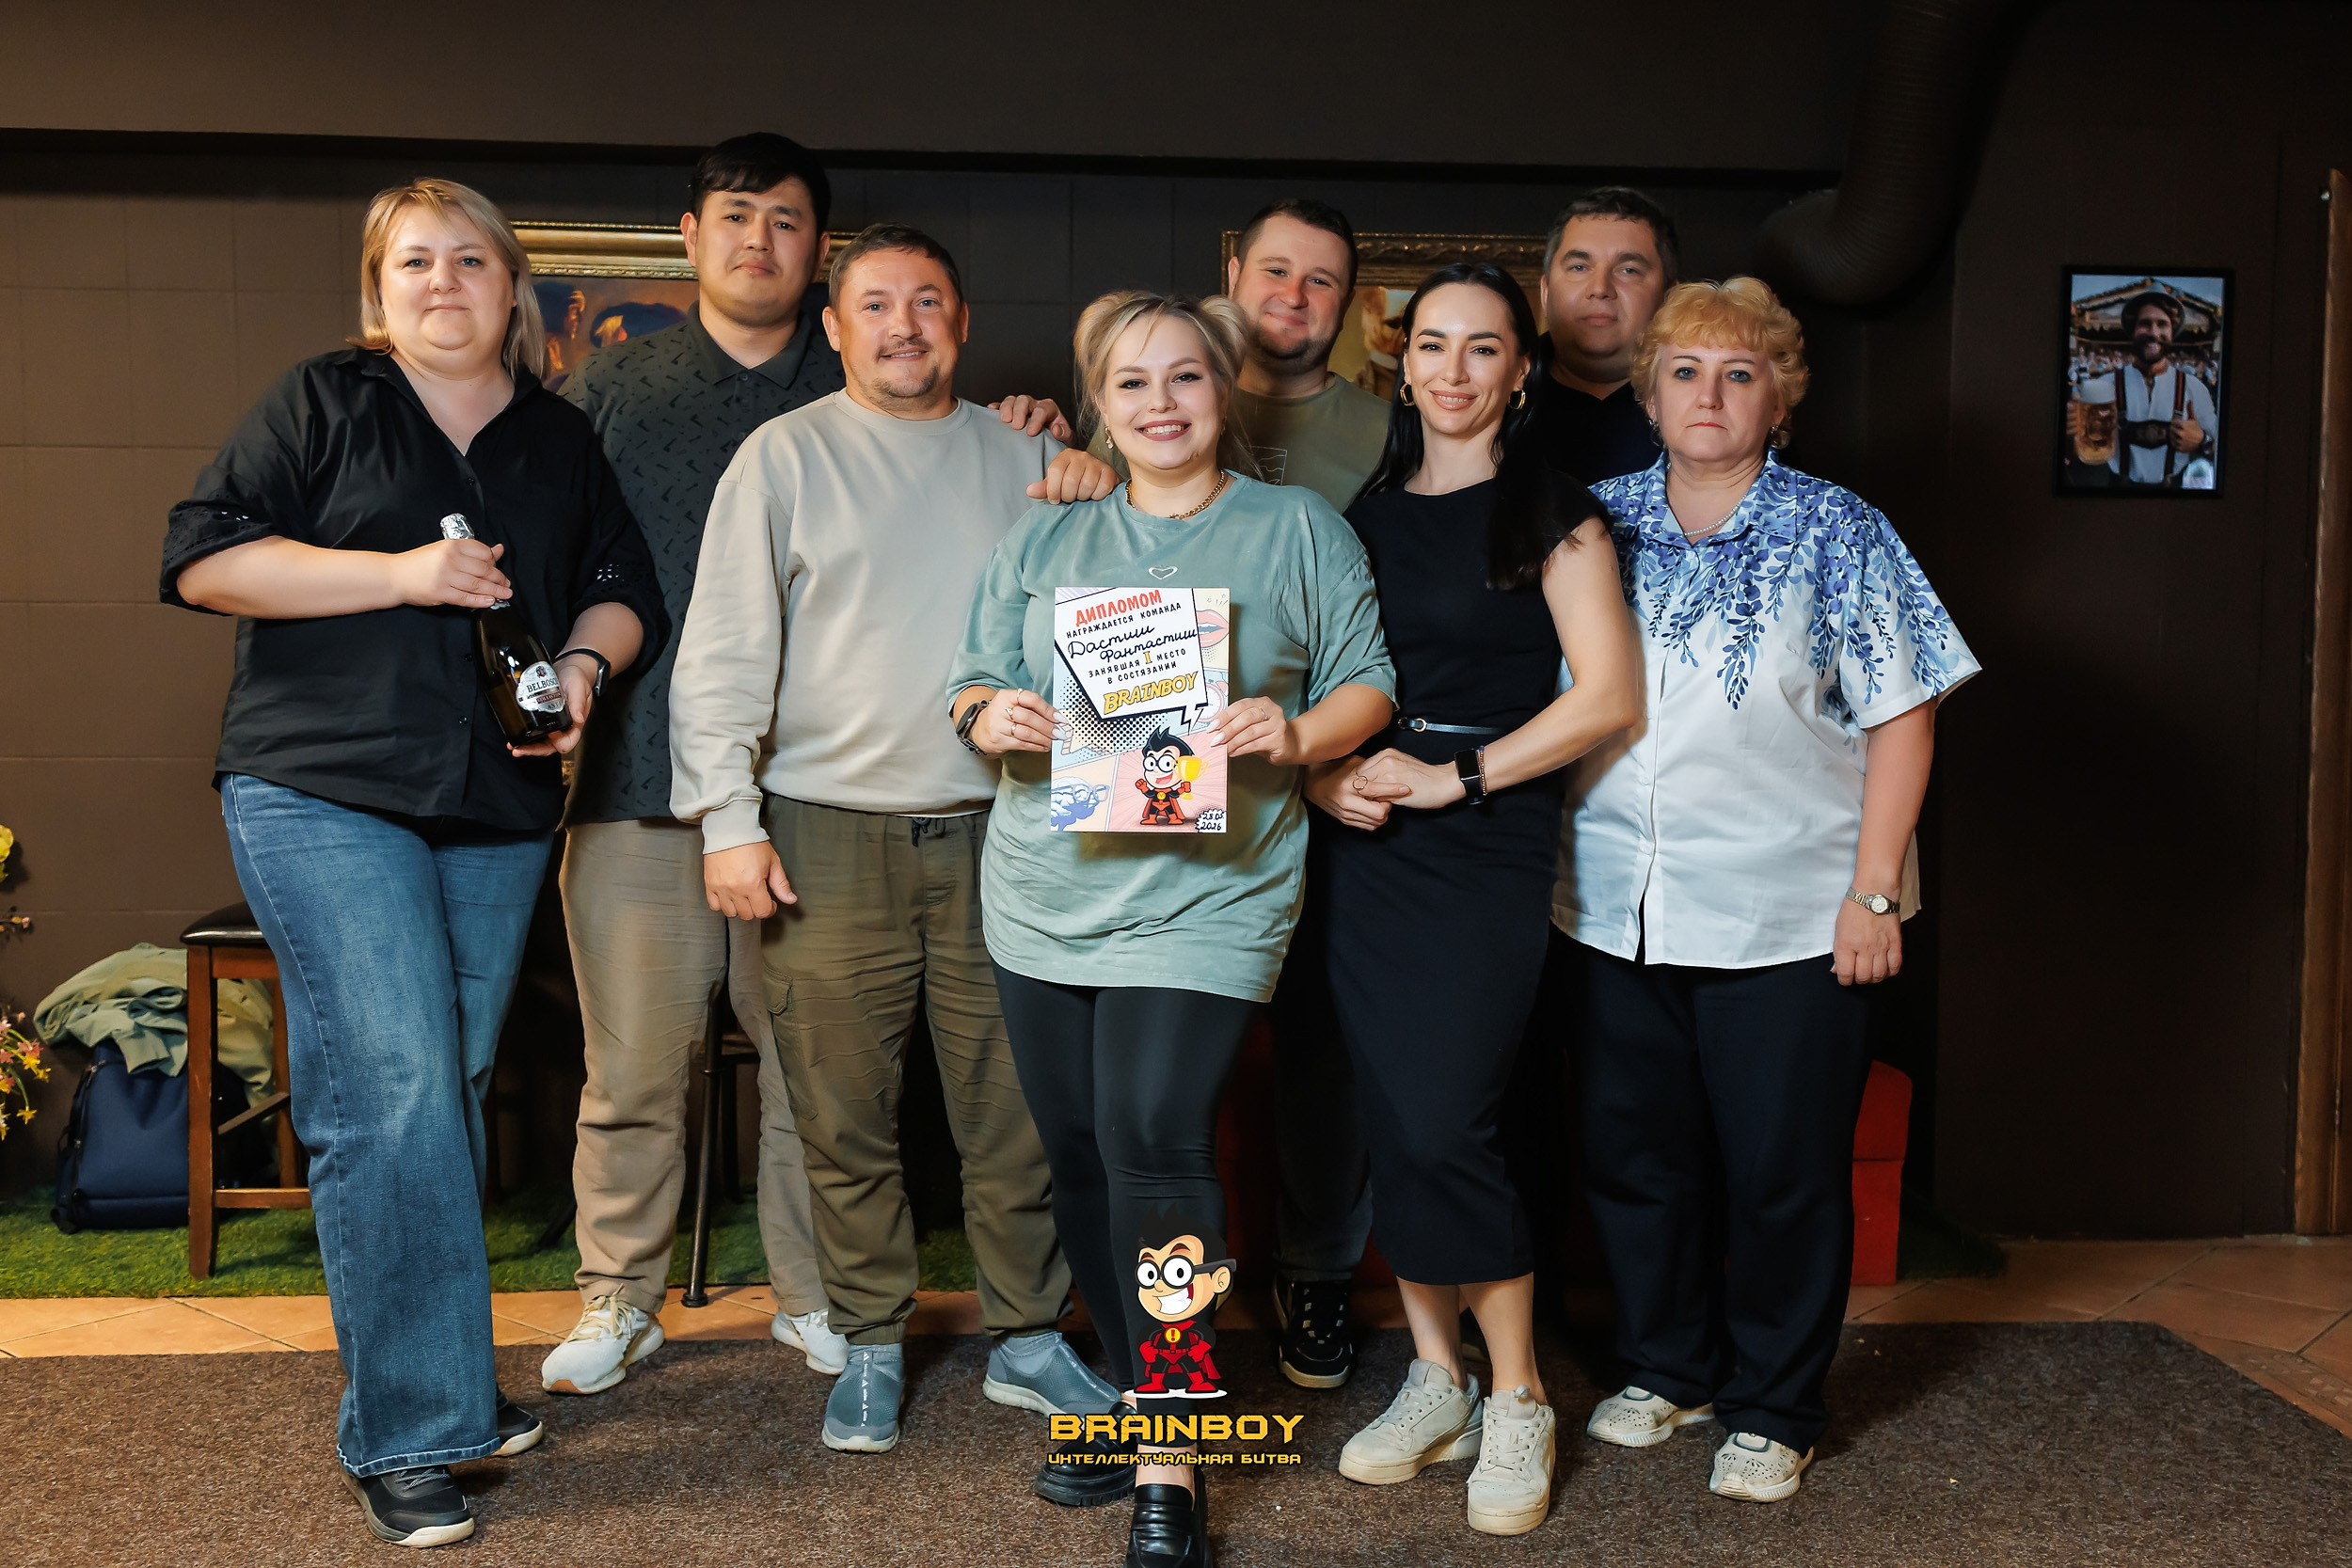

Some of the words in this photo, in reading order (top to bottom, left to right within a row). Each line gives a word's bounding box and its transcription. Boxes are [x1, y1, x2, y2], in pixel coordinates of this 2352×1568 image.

[1066, 615, 1134, 639] НАГРАЖДАЕТСЯ
[1140, 602, 1182, 619] КОМАНДА
[1075, 590, 1162, 626] ДИПЛОМОМ
[1088, 659, 1140, 678] ЗАНЯВШАЯ
[1156, 648, 1186, 662] МЕСТО
[1118, 660, 1177, 682] СОСТЯЗАНИИ
[1104, 671, 1200, 715] BRAINBOY
[1200, 821, 1221, 831] 2026
